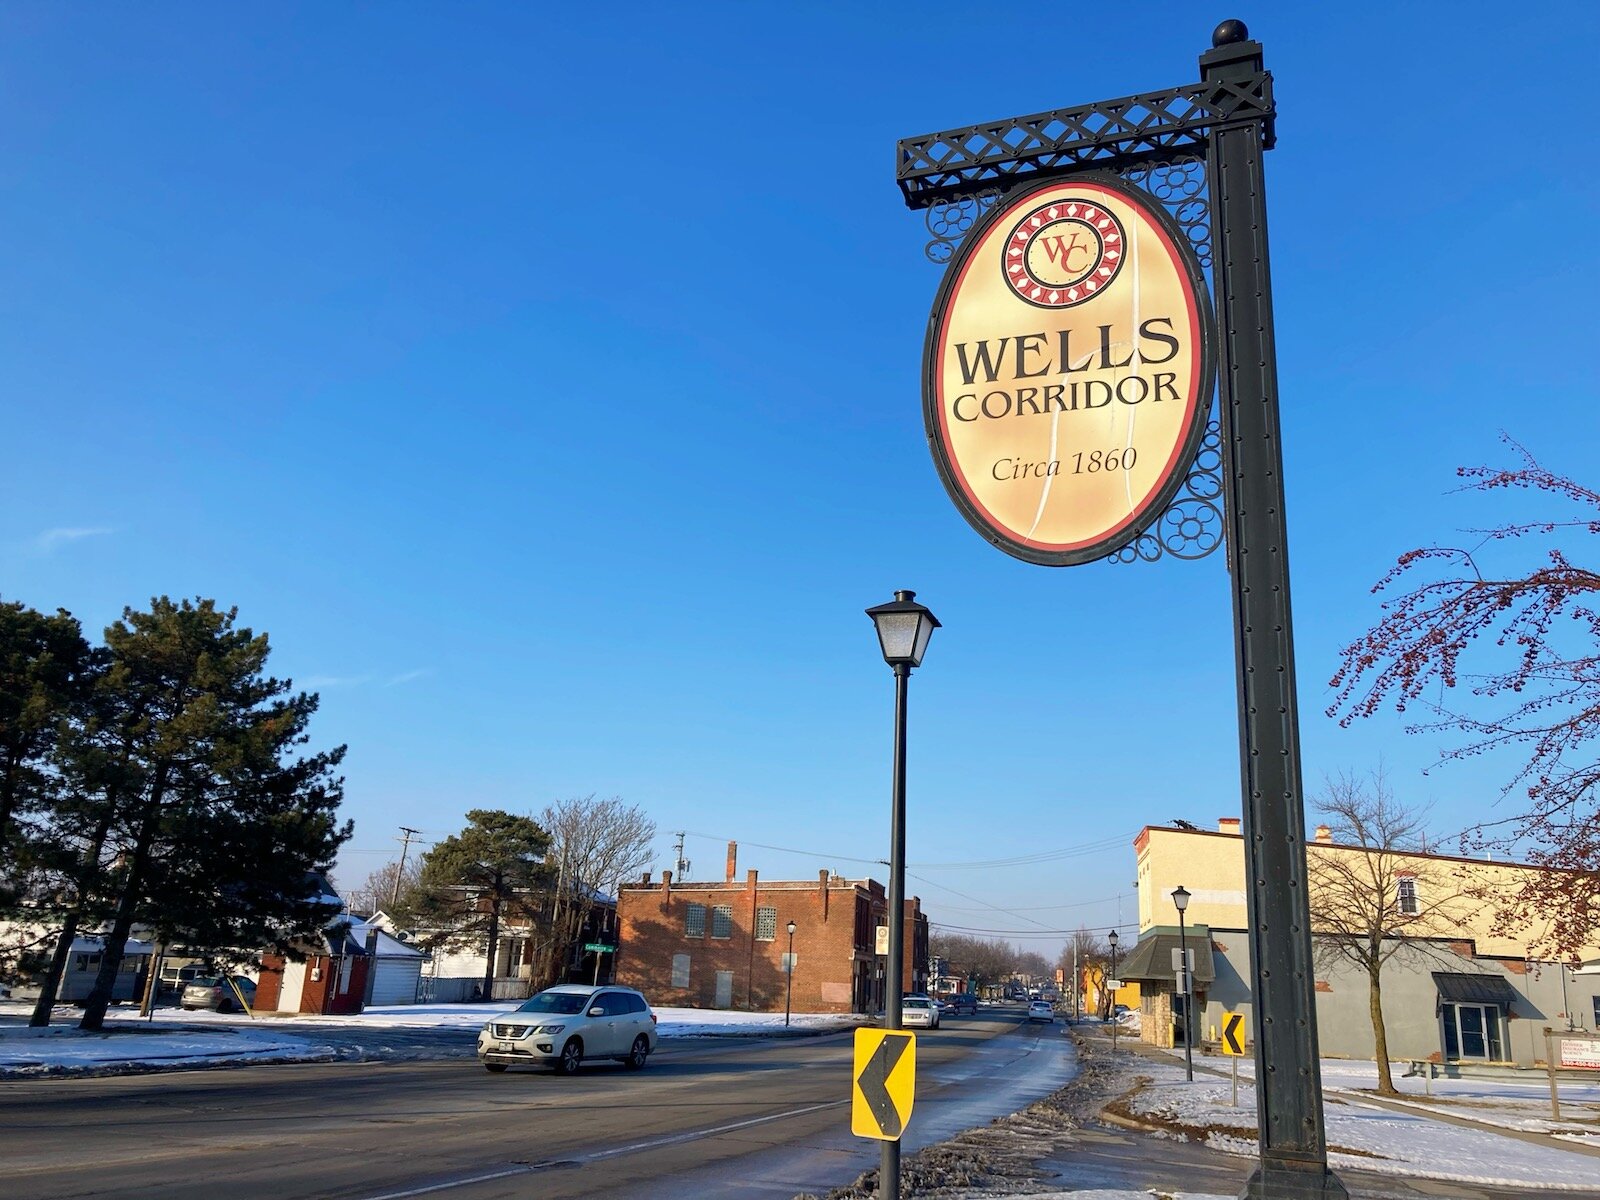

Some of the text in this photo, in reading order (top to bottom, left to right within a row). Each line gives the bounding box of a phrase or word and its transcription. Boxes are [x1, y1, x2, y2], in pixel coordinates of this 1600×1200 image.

[1039, 233, 1088, 273] WC
[954, 317, 1180, 385] WELLS
[953, 372, 1181, 423] CORRIDOR
[992, 447, 1138, 481] Circa 1860
